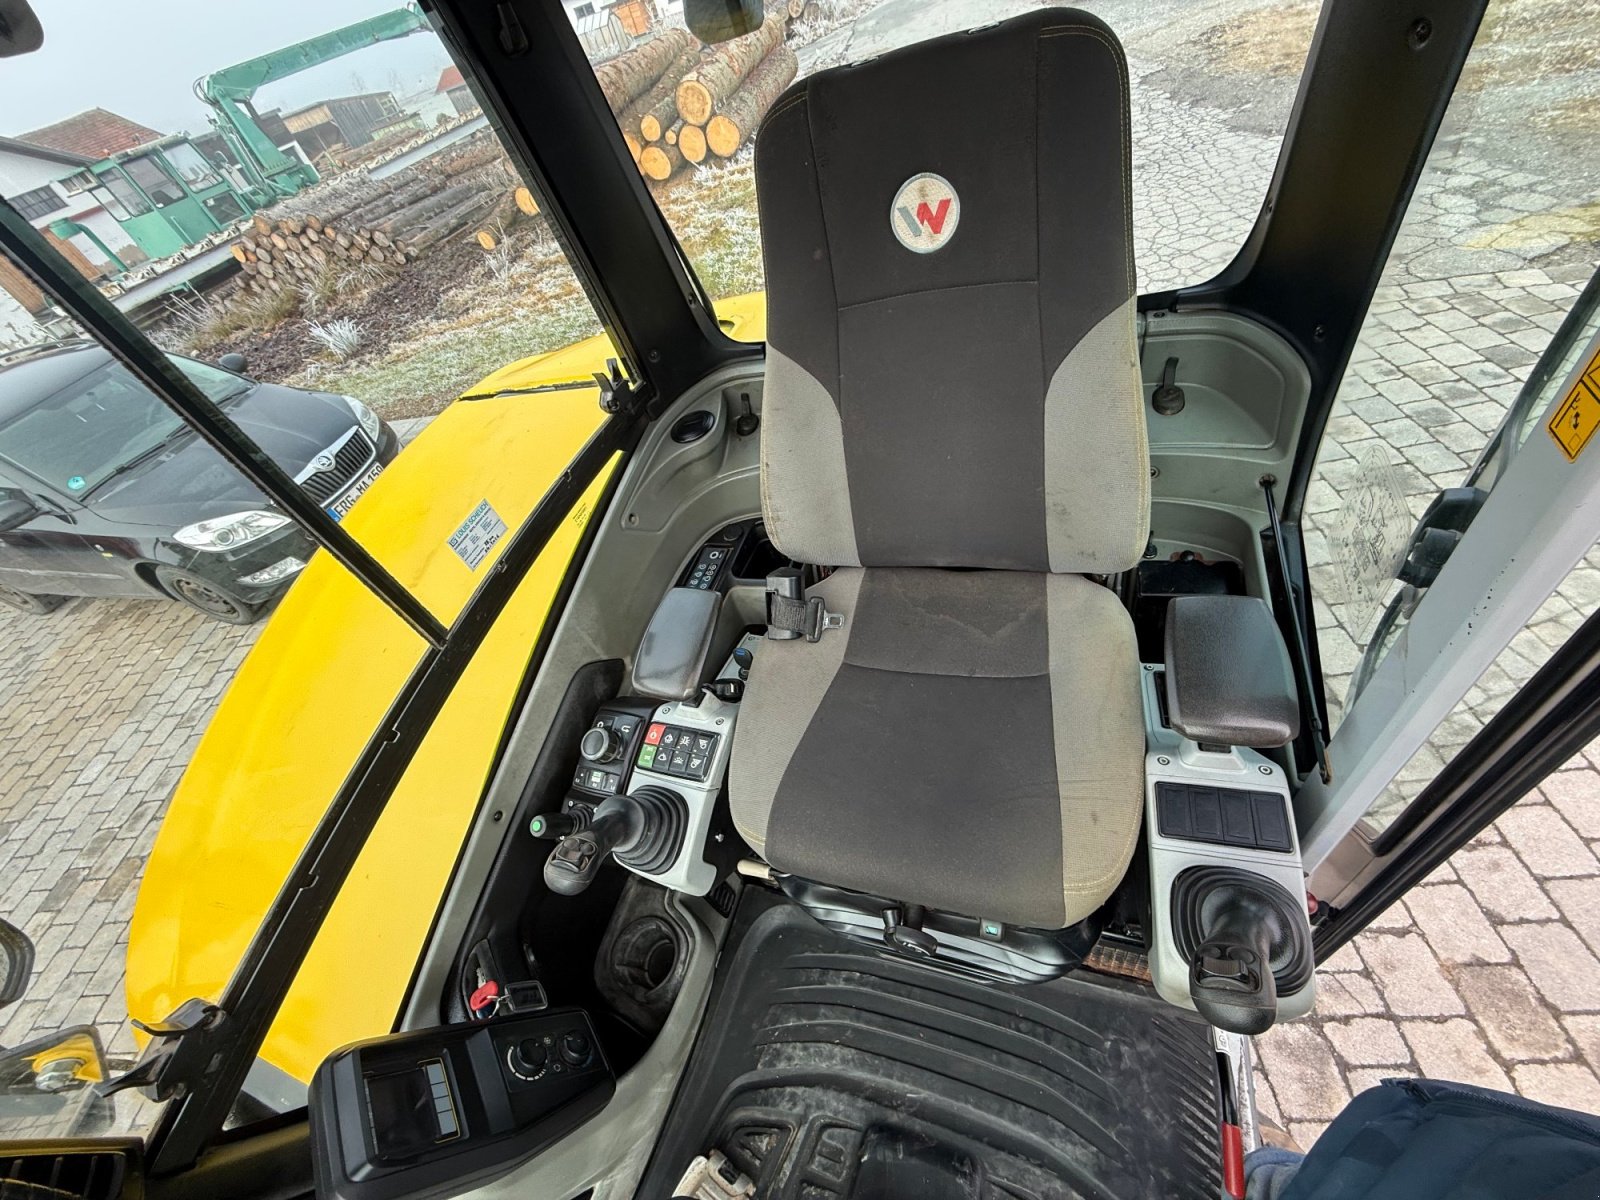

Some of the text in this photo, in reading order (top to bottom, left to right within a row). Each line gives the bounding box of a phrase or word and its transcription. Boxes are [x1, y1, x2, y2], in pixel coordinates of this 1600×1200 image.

[333, 494, 356, 518] FRG
[355, 480, 370, 495] MA
[455, 521, 471, 540] LOUIS
[468, 501, 489, 524] SCHEUCH
